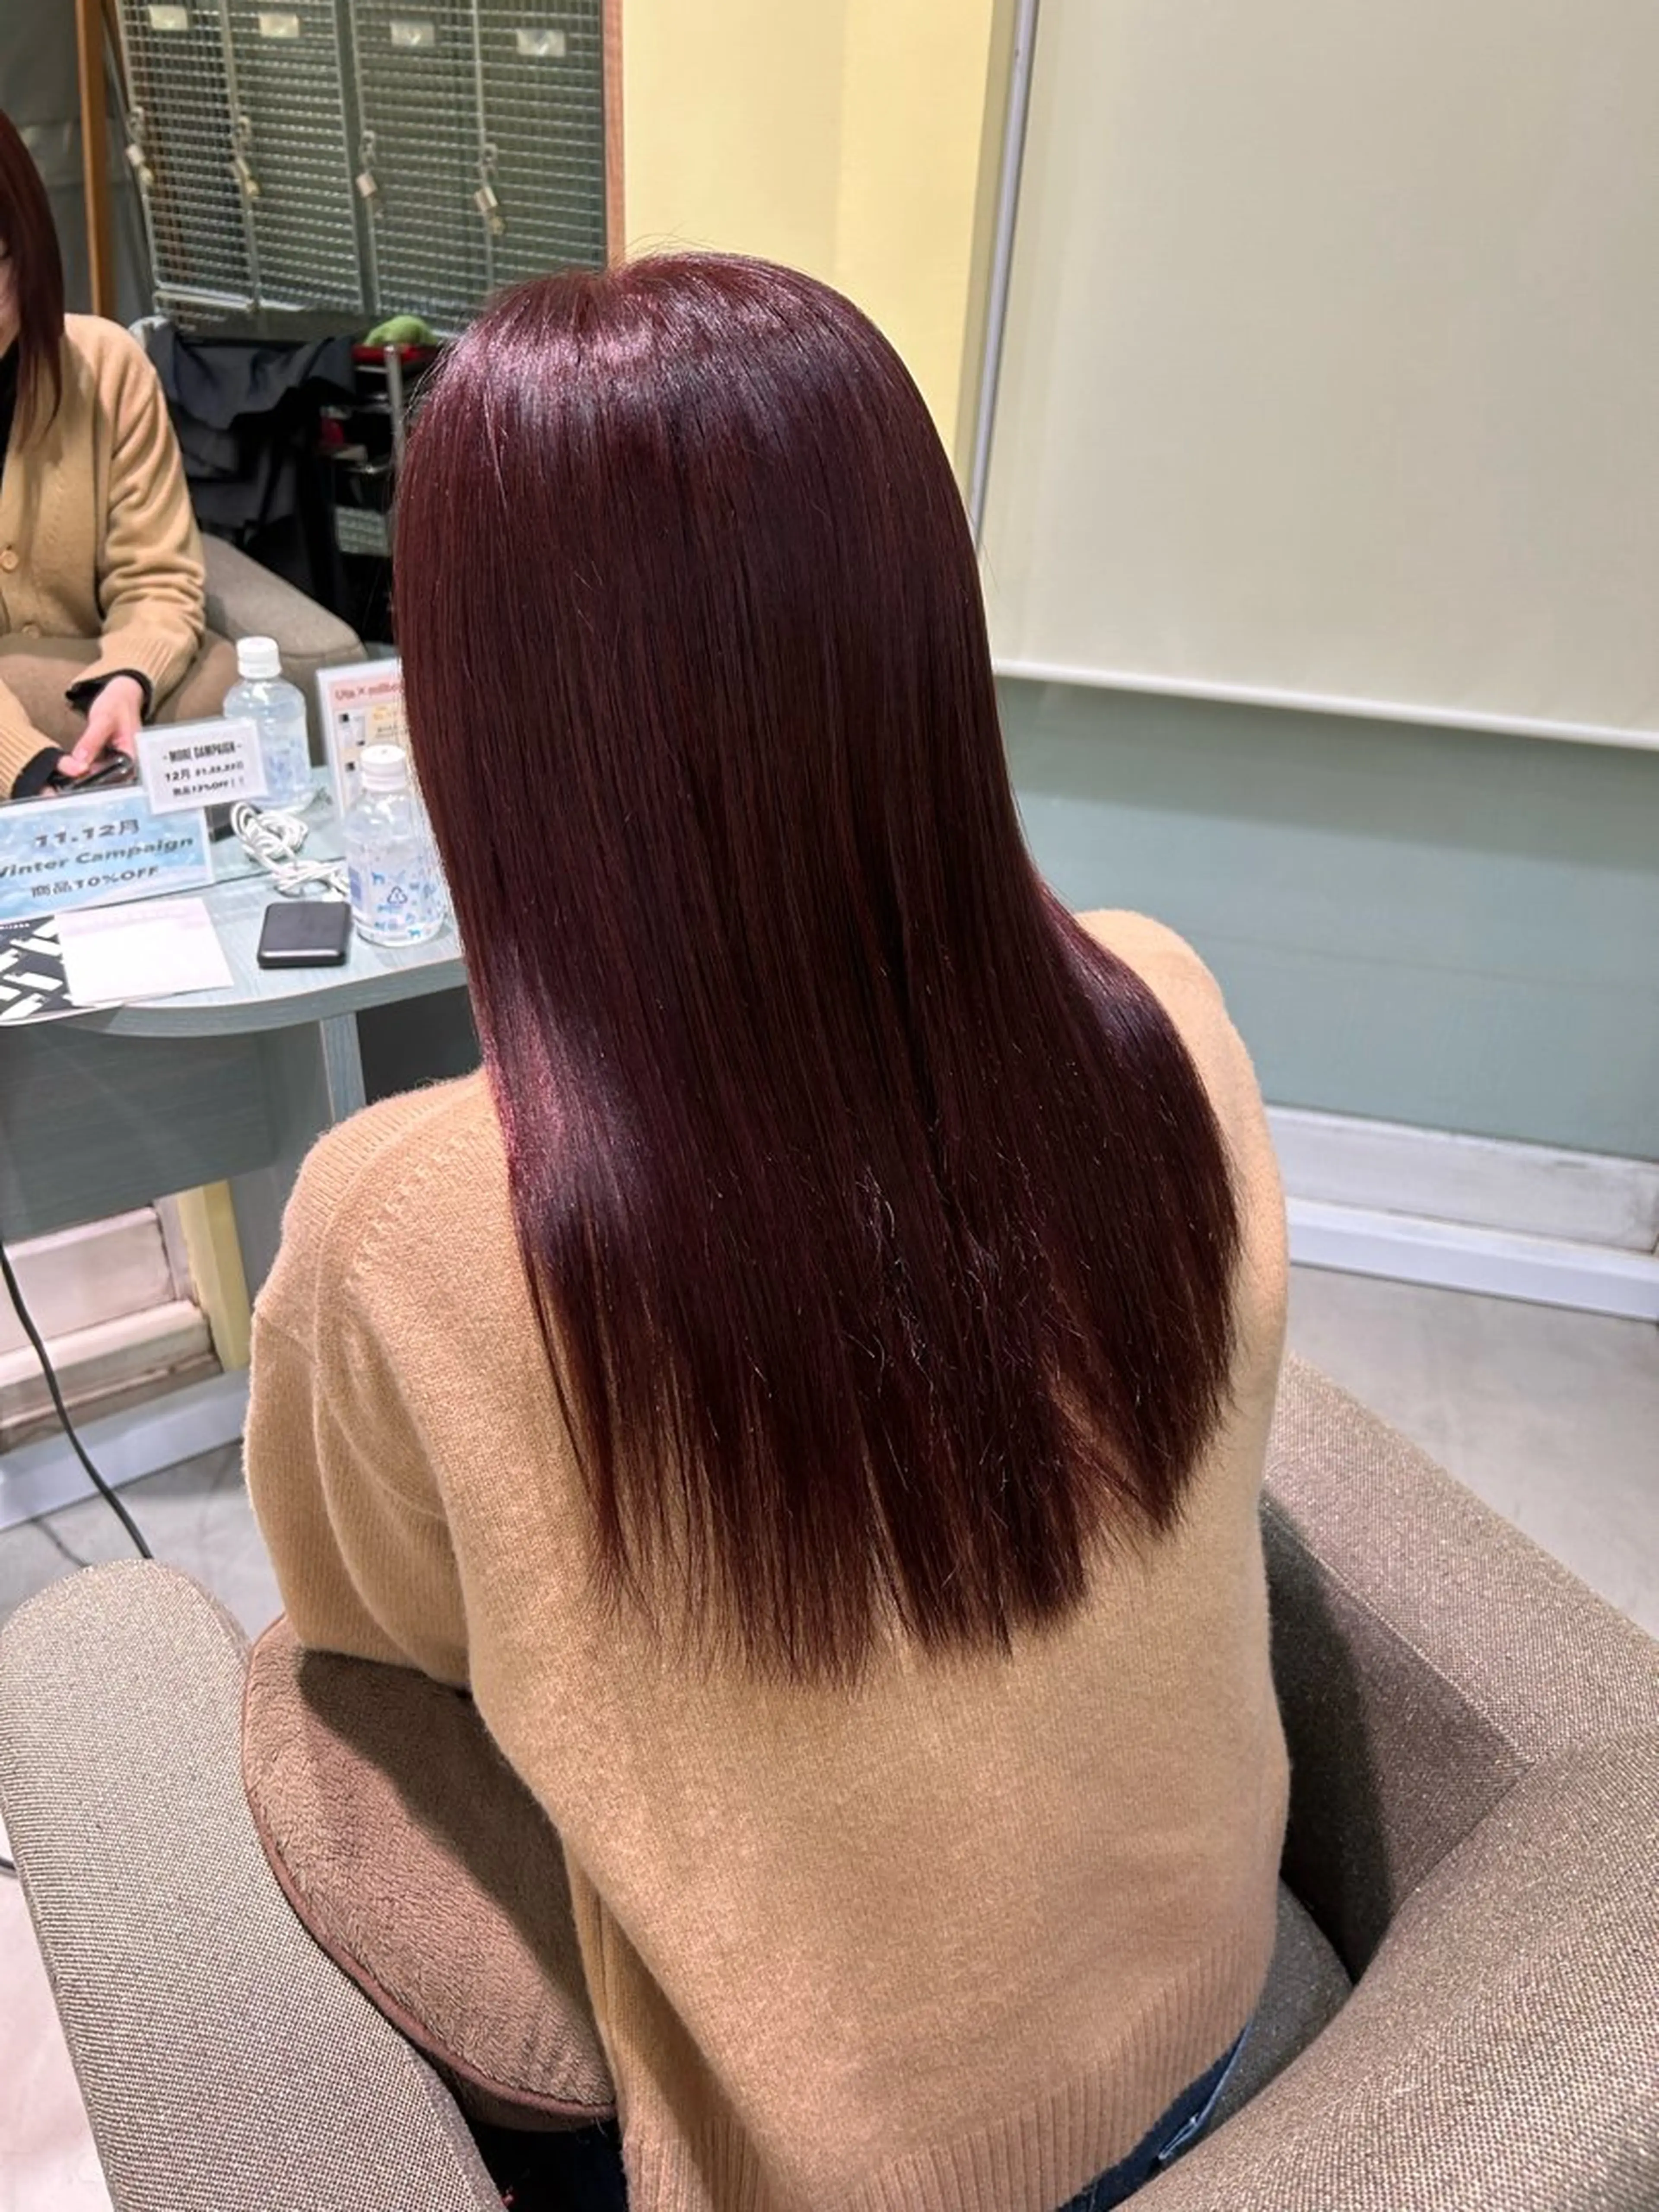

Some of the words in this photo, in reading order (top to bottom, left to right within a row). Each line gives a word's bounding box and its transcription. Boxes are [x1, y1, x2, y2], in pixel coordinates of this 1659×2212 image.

[194, 741, 236, 759] CAMPAIGN
[165, 768, 191, 782] 12月
[35, 819, 140, 848] 11.12月
[75, 837, 194, 864] Campaign
[31, 865, 159, 899] 商品10%OFF
